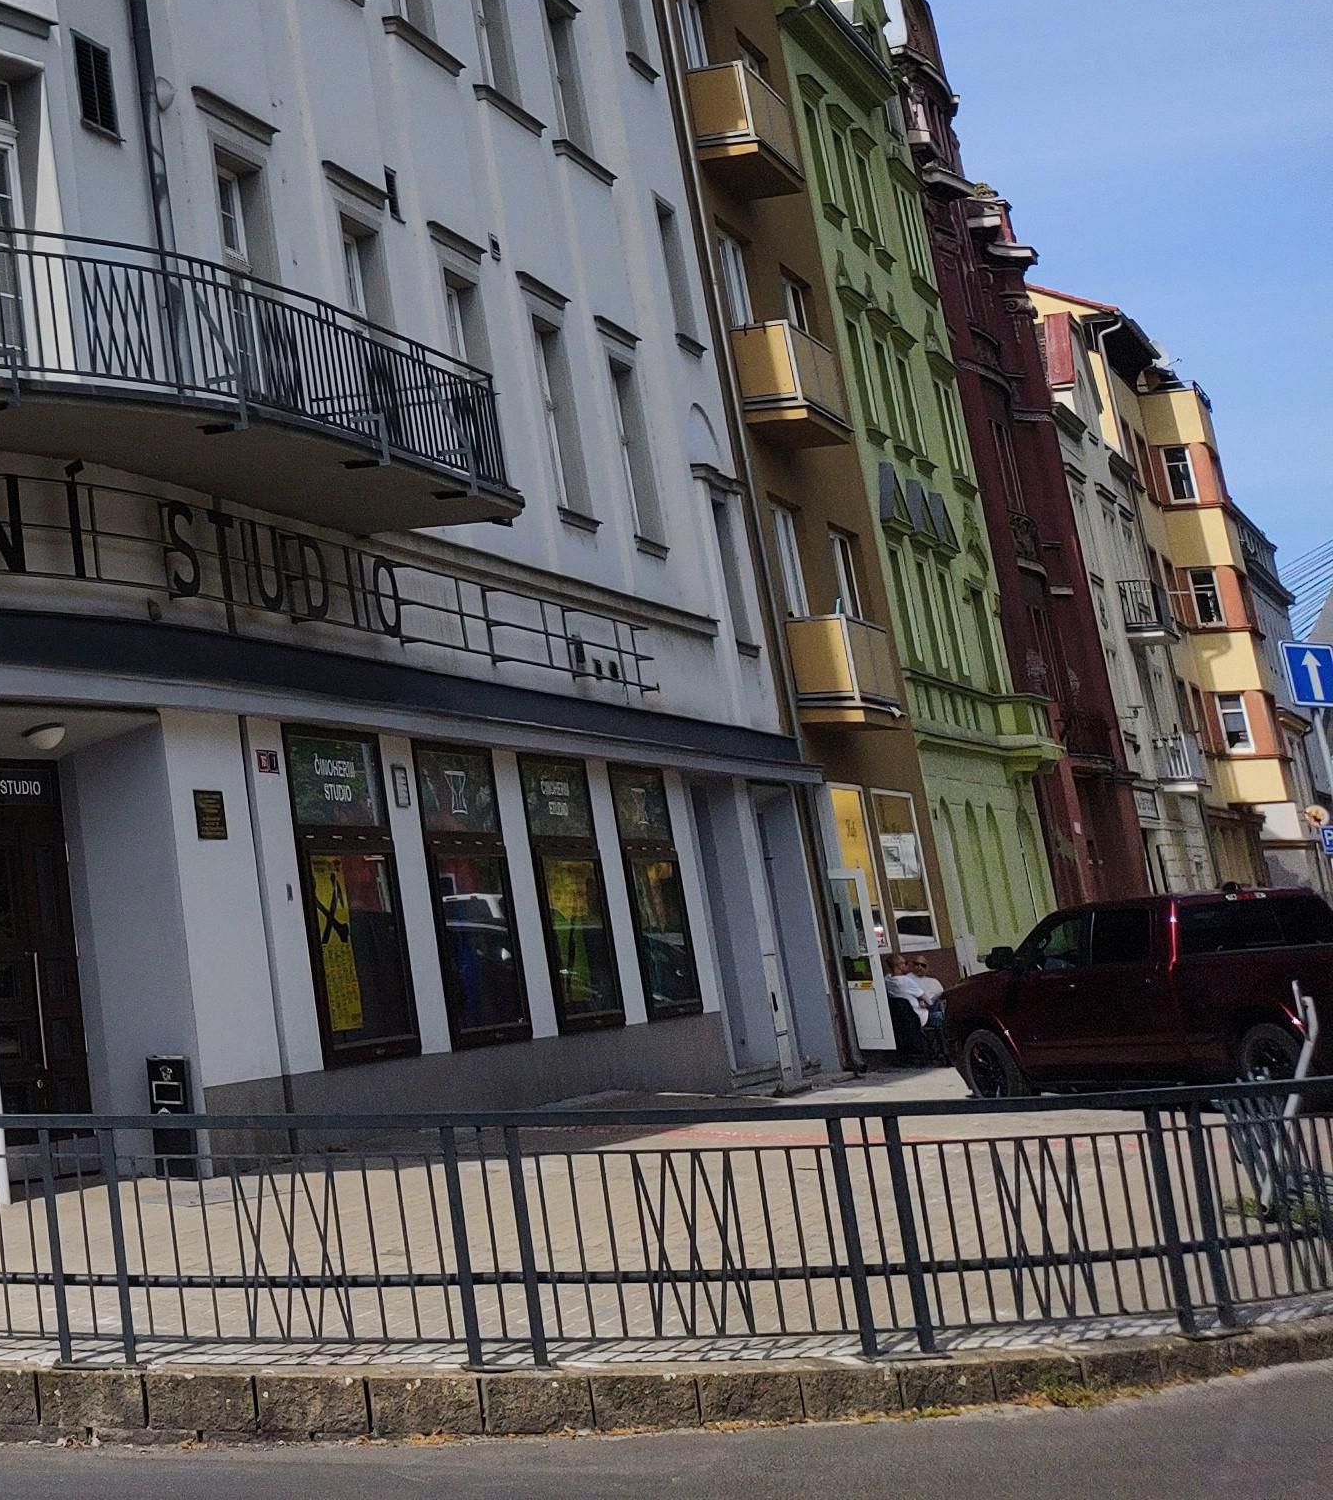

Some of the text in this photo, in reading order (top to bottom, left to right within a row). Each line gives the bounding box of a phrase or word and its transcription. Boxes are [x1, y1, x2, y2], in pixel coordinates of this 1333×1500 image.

[166, 501, 402, 638] STUDIO
[0, 779, 42, 796] STUDIO
[324, 783, 352, 802] STUDIO
